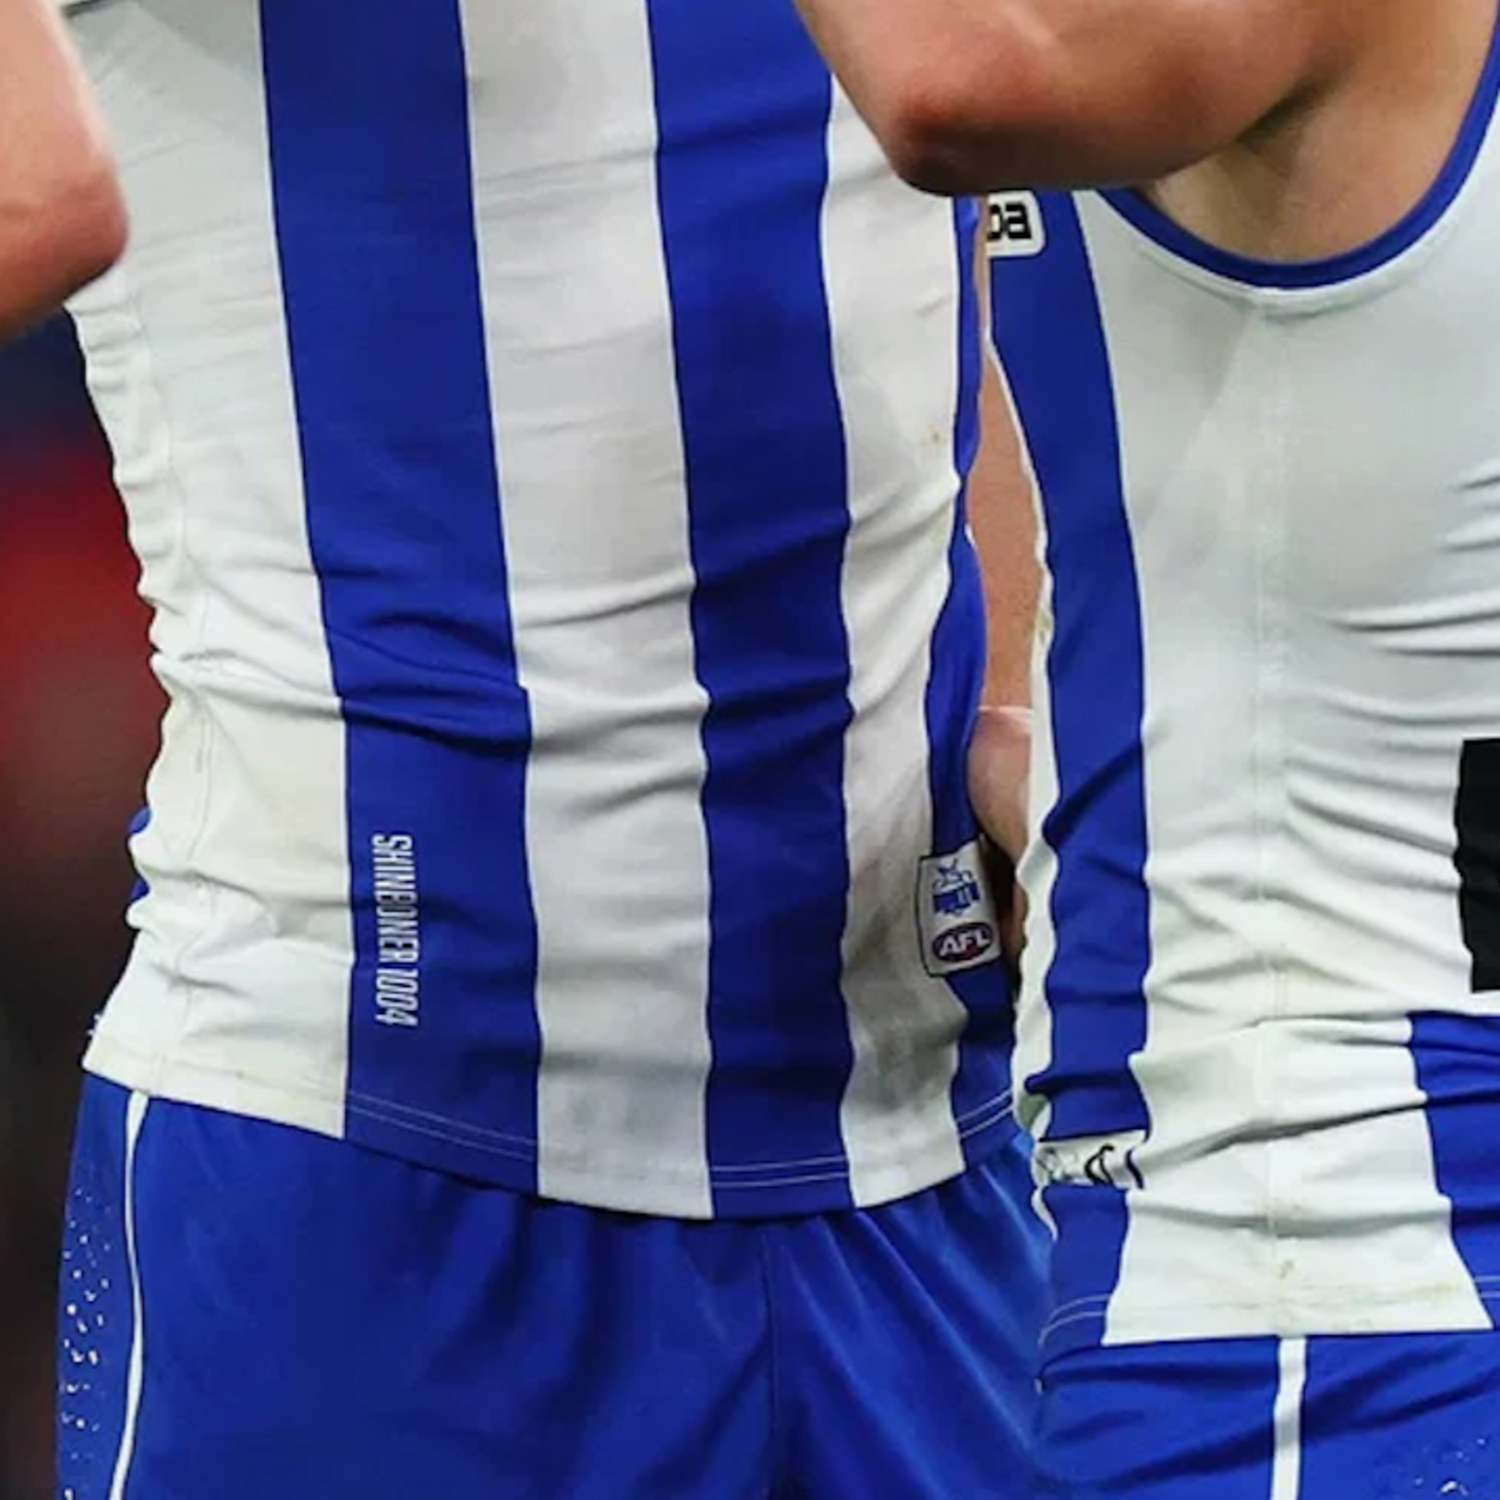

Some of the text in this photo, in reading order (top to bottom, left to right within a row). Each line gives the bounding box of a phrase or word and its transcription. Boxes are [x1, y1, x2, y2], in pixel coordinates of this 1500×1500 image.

[371, 833, 419, 1027] SHINBONER 1004
[938, 928, 992, 958] AFL
